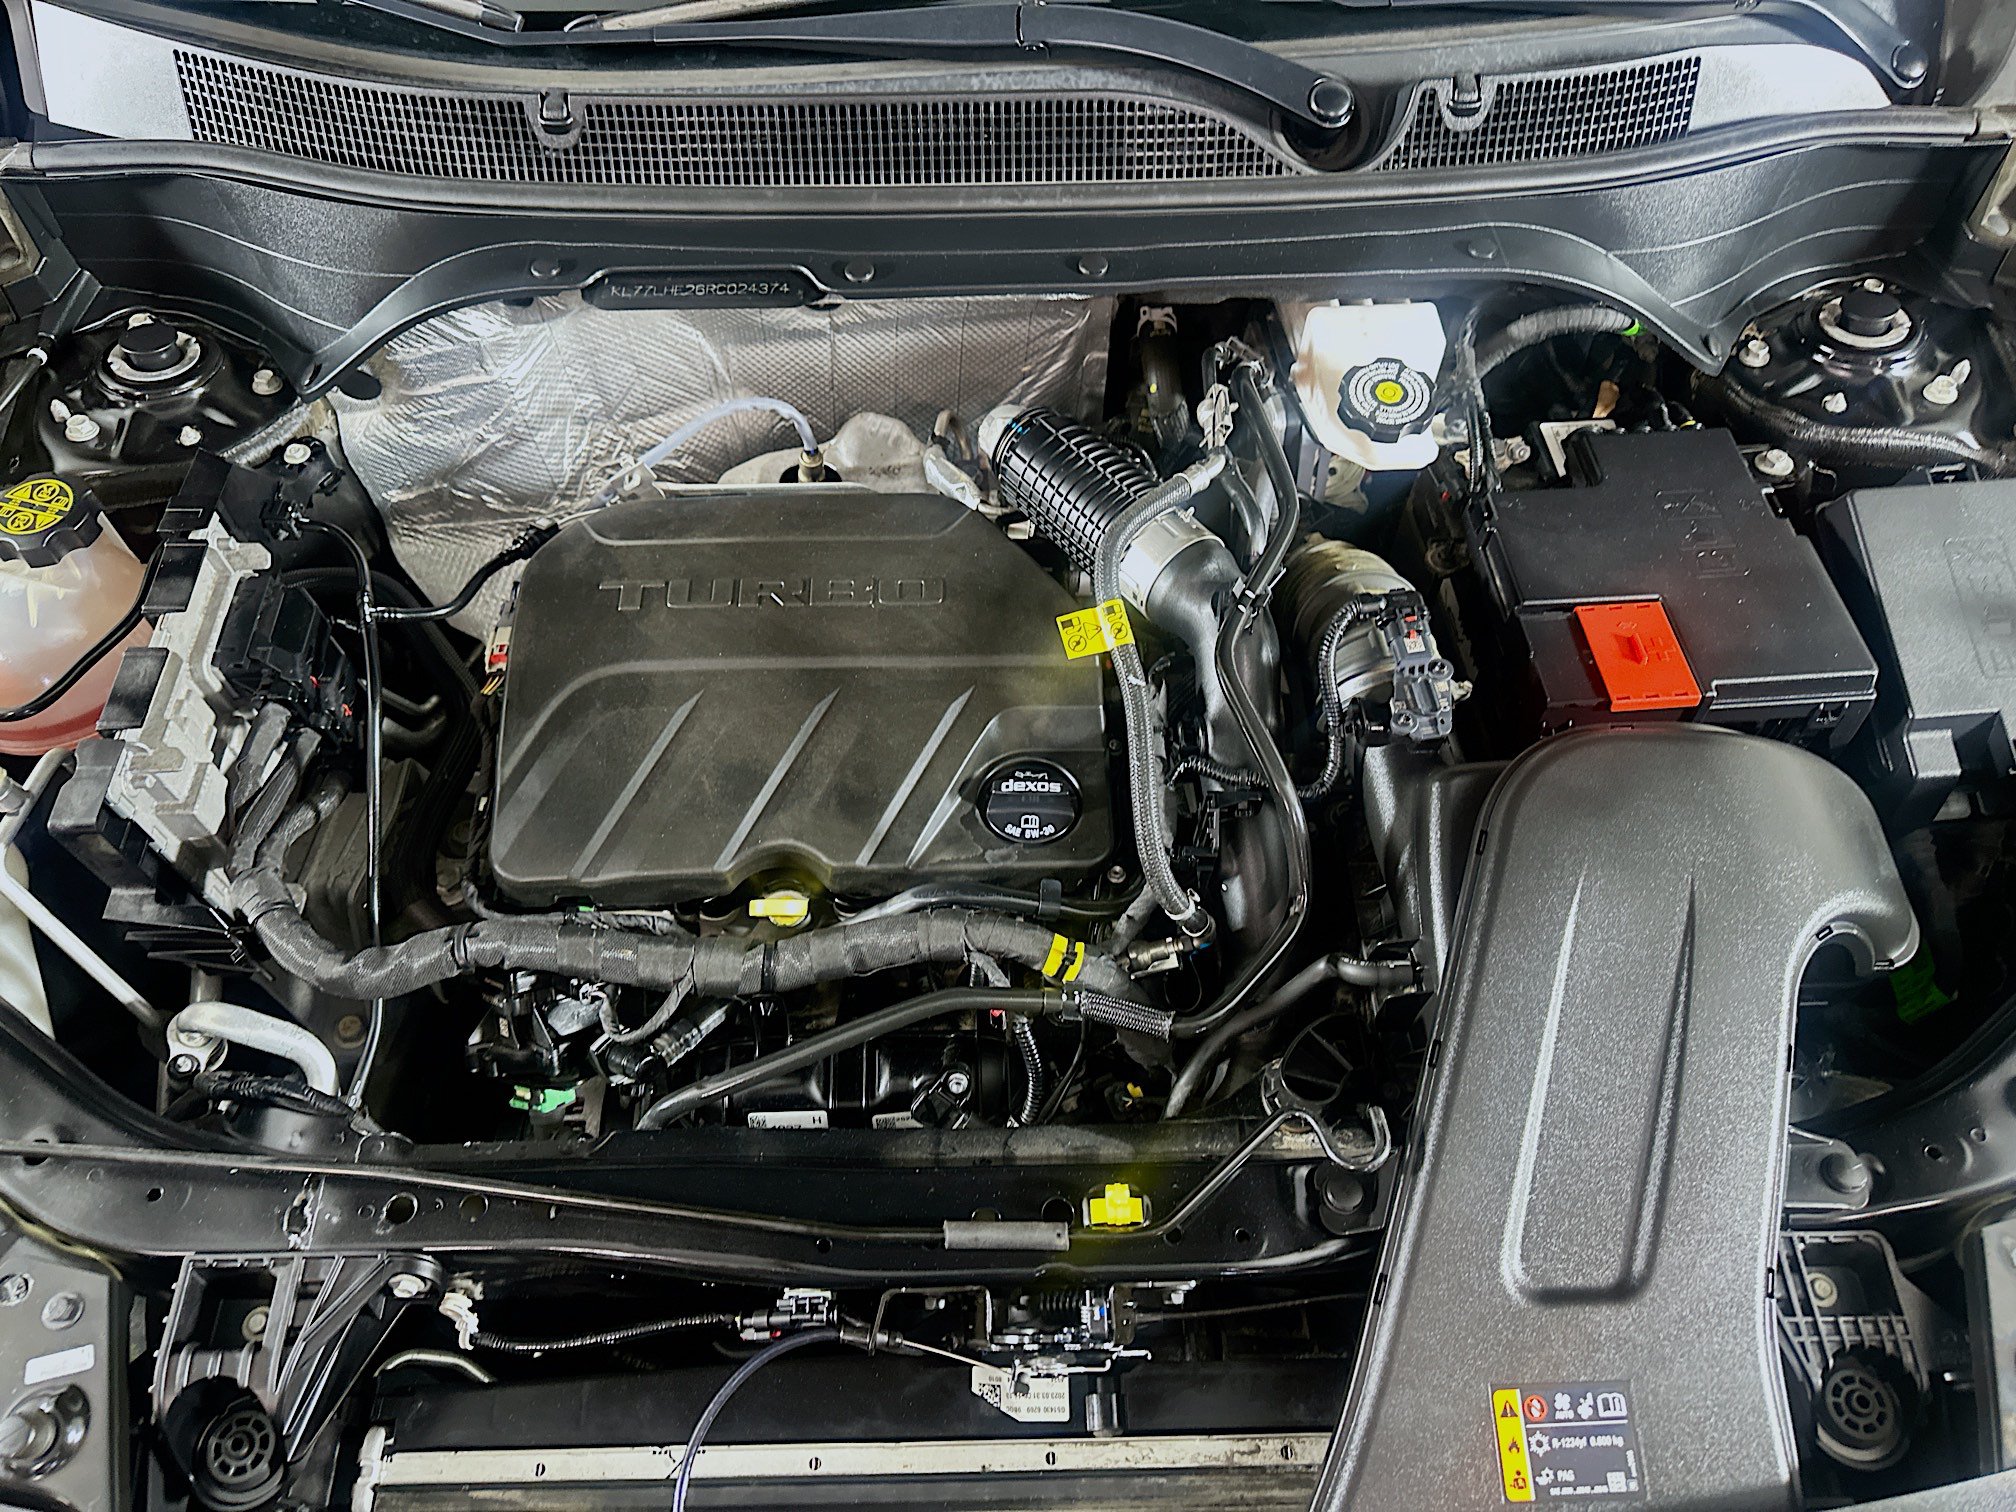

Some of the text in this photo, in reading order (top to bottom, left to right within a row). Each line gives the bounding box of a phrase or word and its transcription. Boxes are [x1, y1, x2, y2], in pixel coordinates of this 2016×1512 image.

[599, 577, 946, 610] TURBO
[1001, 779, 1061, 792] dexos
[1004, 824, 1022, 837] SAE
